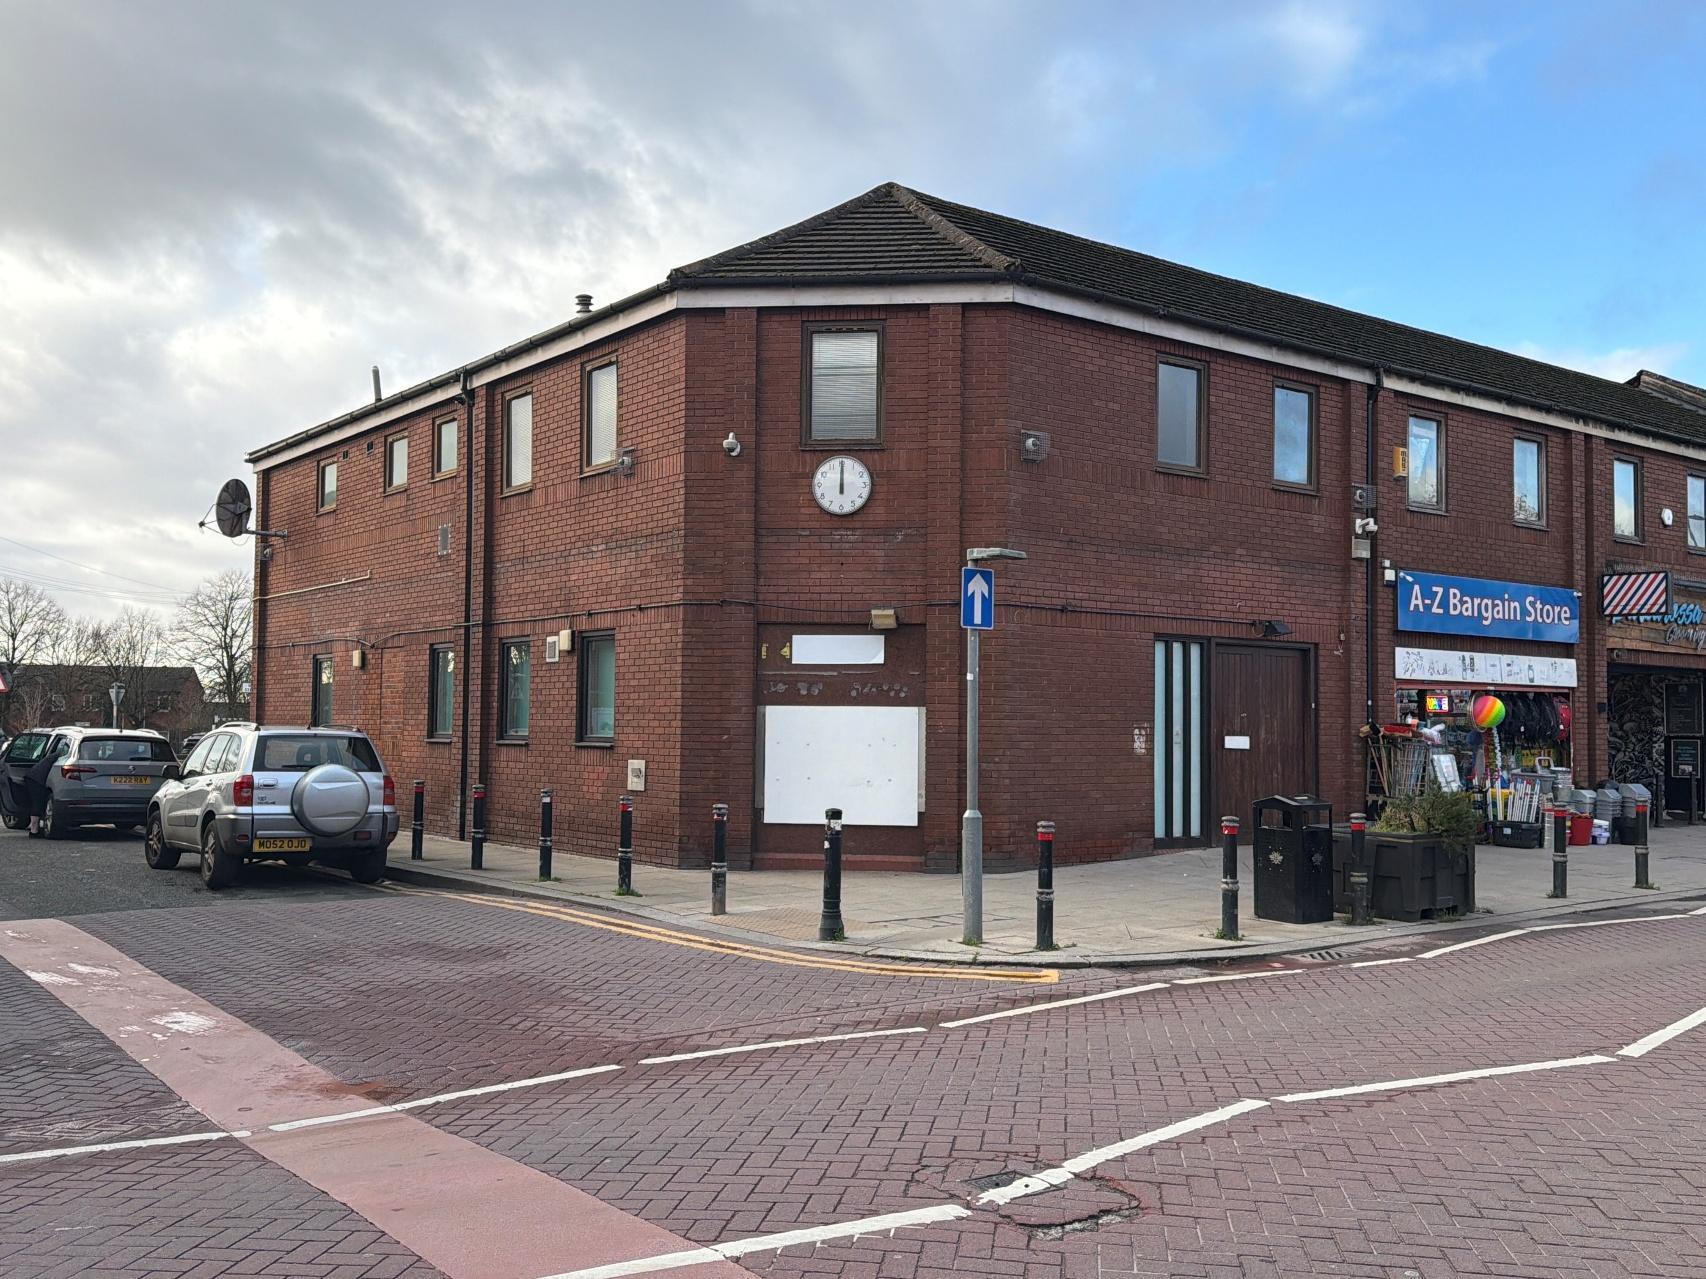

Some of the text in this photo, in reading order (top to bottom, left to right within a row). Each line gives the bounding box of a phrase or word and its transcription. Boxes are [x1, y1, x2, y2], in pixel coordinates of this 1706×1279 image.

[1410, 584, 1570, 626] A-Z Bargain Store
